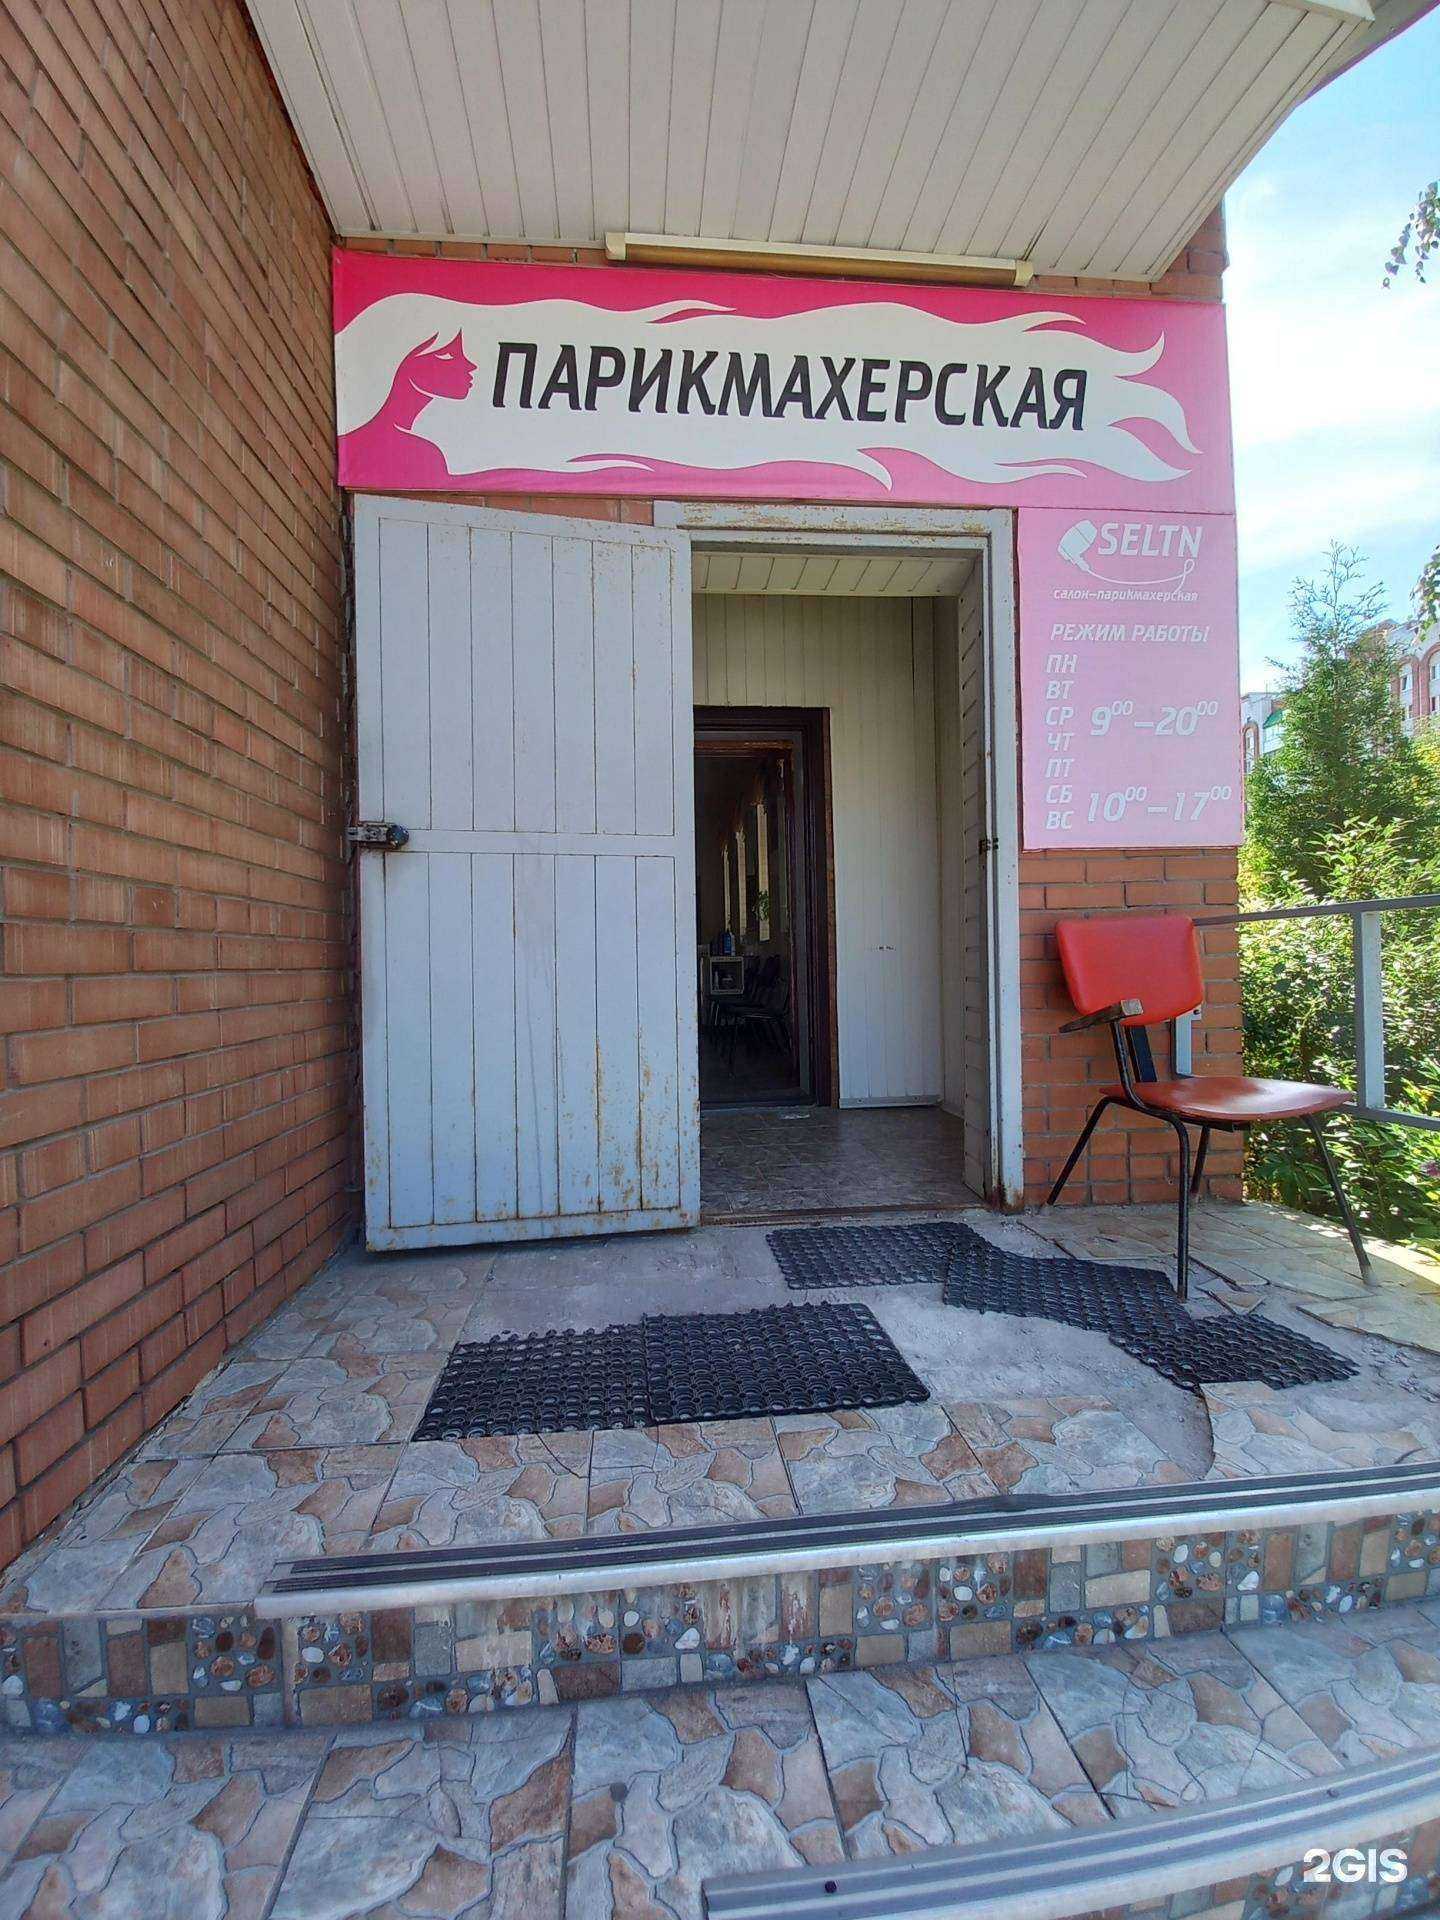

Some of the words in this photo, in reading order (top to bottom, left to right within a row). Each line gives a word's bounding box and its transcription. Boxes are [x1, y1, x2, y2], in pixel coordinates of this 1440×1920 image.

[492, 341, 1088, 431] ПАРИКМАХЕРСКАЯ
[1098, 523, 1203, 558] SELTN
[1050, 624, 1125, 642] РЕЖИМ
[1131, 624, 1210, 643] РАБОТЫ
[1046, 654, 1078, 673] ПН
[1046, 680, 1074, 699] ВТ
[1045, 706, 1074, 726] СР
[1047, 732, 1075, 751] ЧТ
[1045, 758, 1075, 778] ПТ
[1046, 785, 1073, 803] СБ
[1046, 811, 1074, 830] ВС
